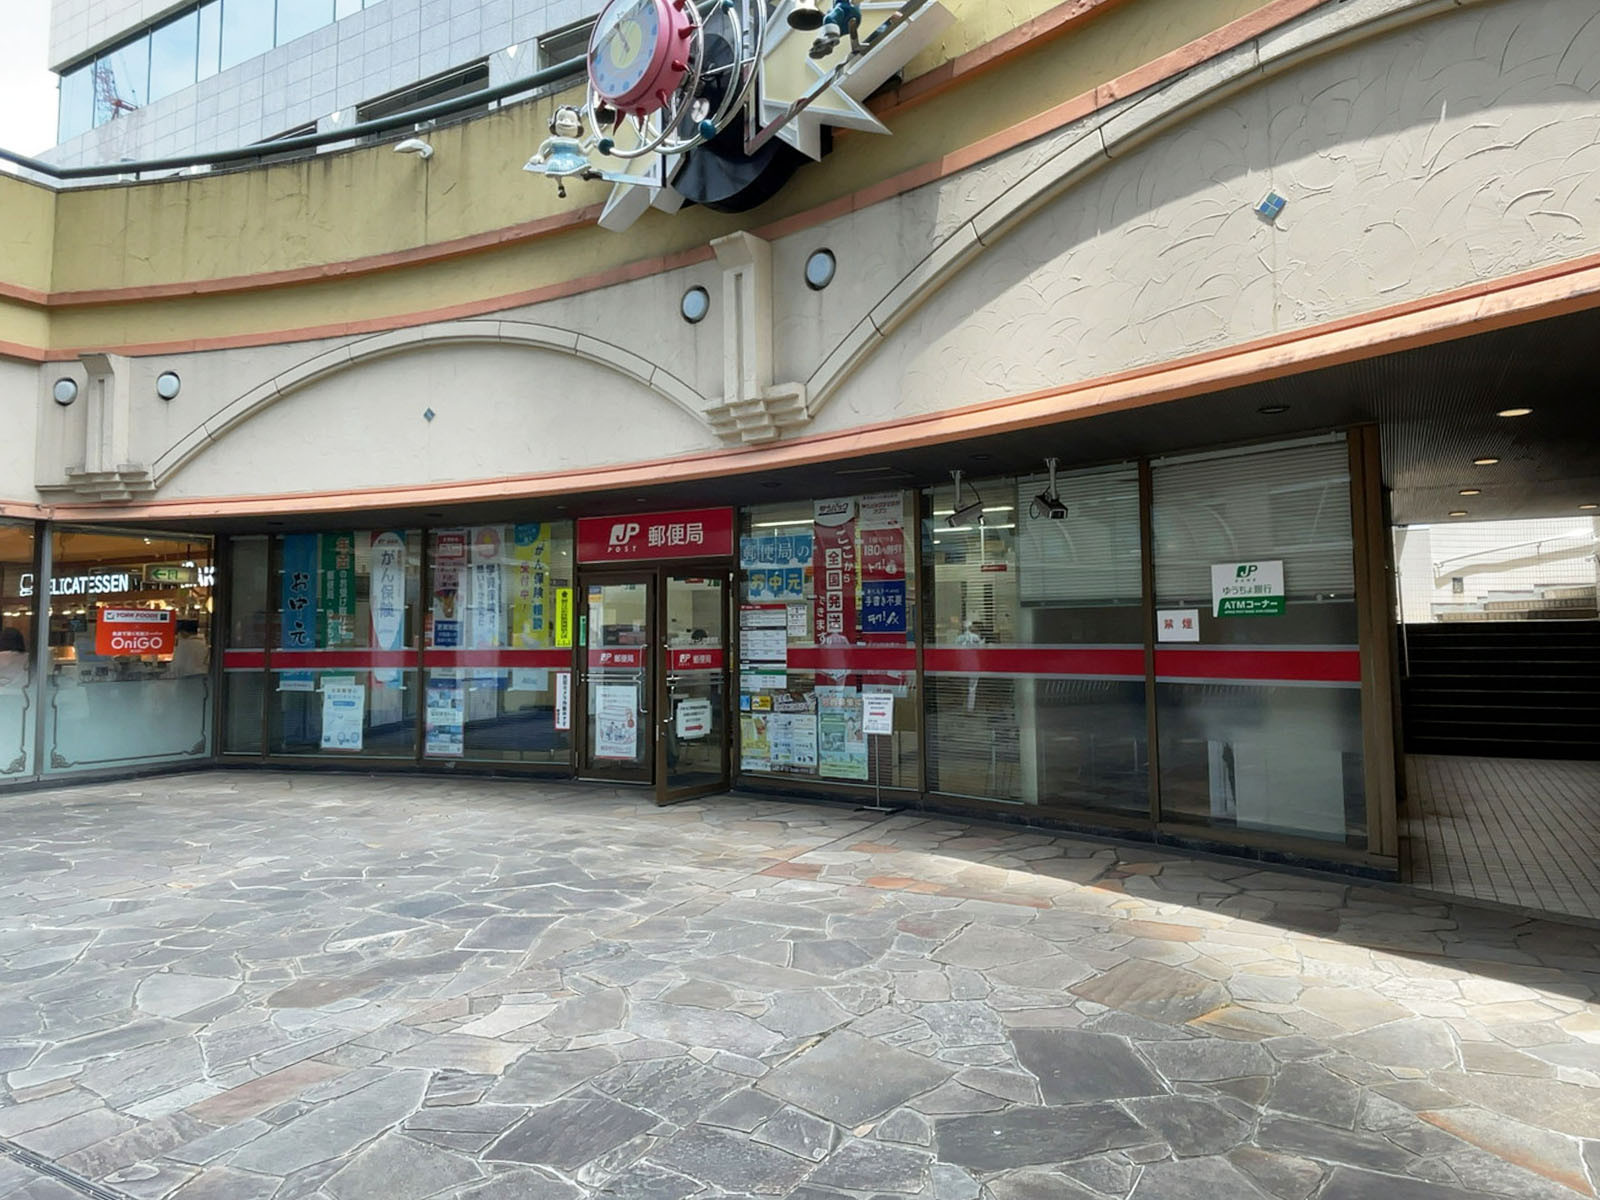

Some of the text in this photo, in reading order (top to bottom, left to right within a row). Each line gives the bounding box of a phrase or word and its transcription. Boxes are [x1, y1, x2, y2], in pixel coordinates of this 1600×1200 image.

[609, 523, 640, 545] JP
[648, 522, 704, 547] 郵便局
[742, 543, 810, 561] 郵便局の
[836, 529, 853, 583] ここから
[1236, 565, 1258, 578] JP
[380, 550, 396, 618] がん保険
[750, 573, 801, 591] お中元
[826, 549, 843, 632] 全国発送
[1222, 584, 1273, 595] ゆうちょ銀行
[288, 571, 310, 646] お中元
[1224, 599, 1278, 609] ATMコーナー
[111, 636, 162, 649] OniGO
